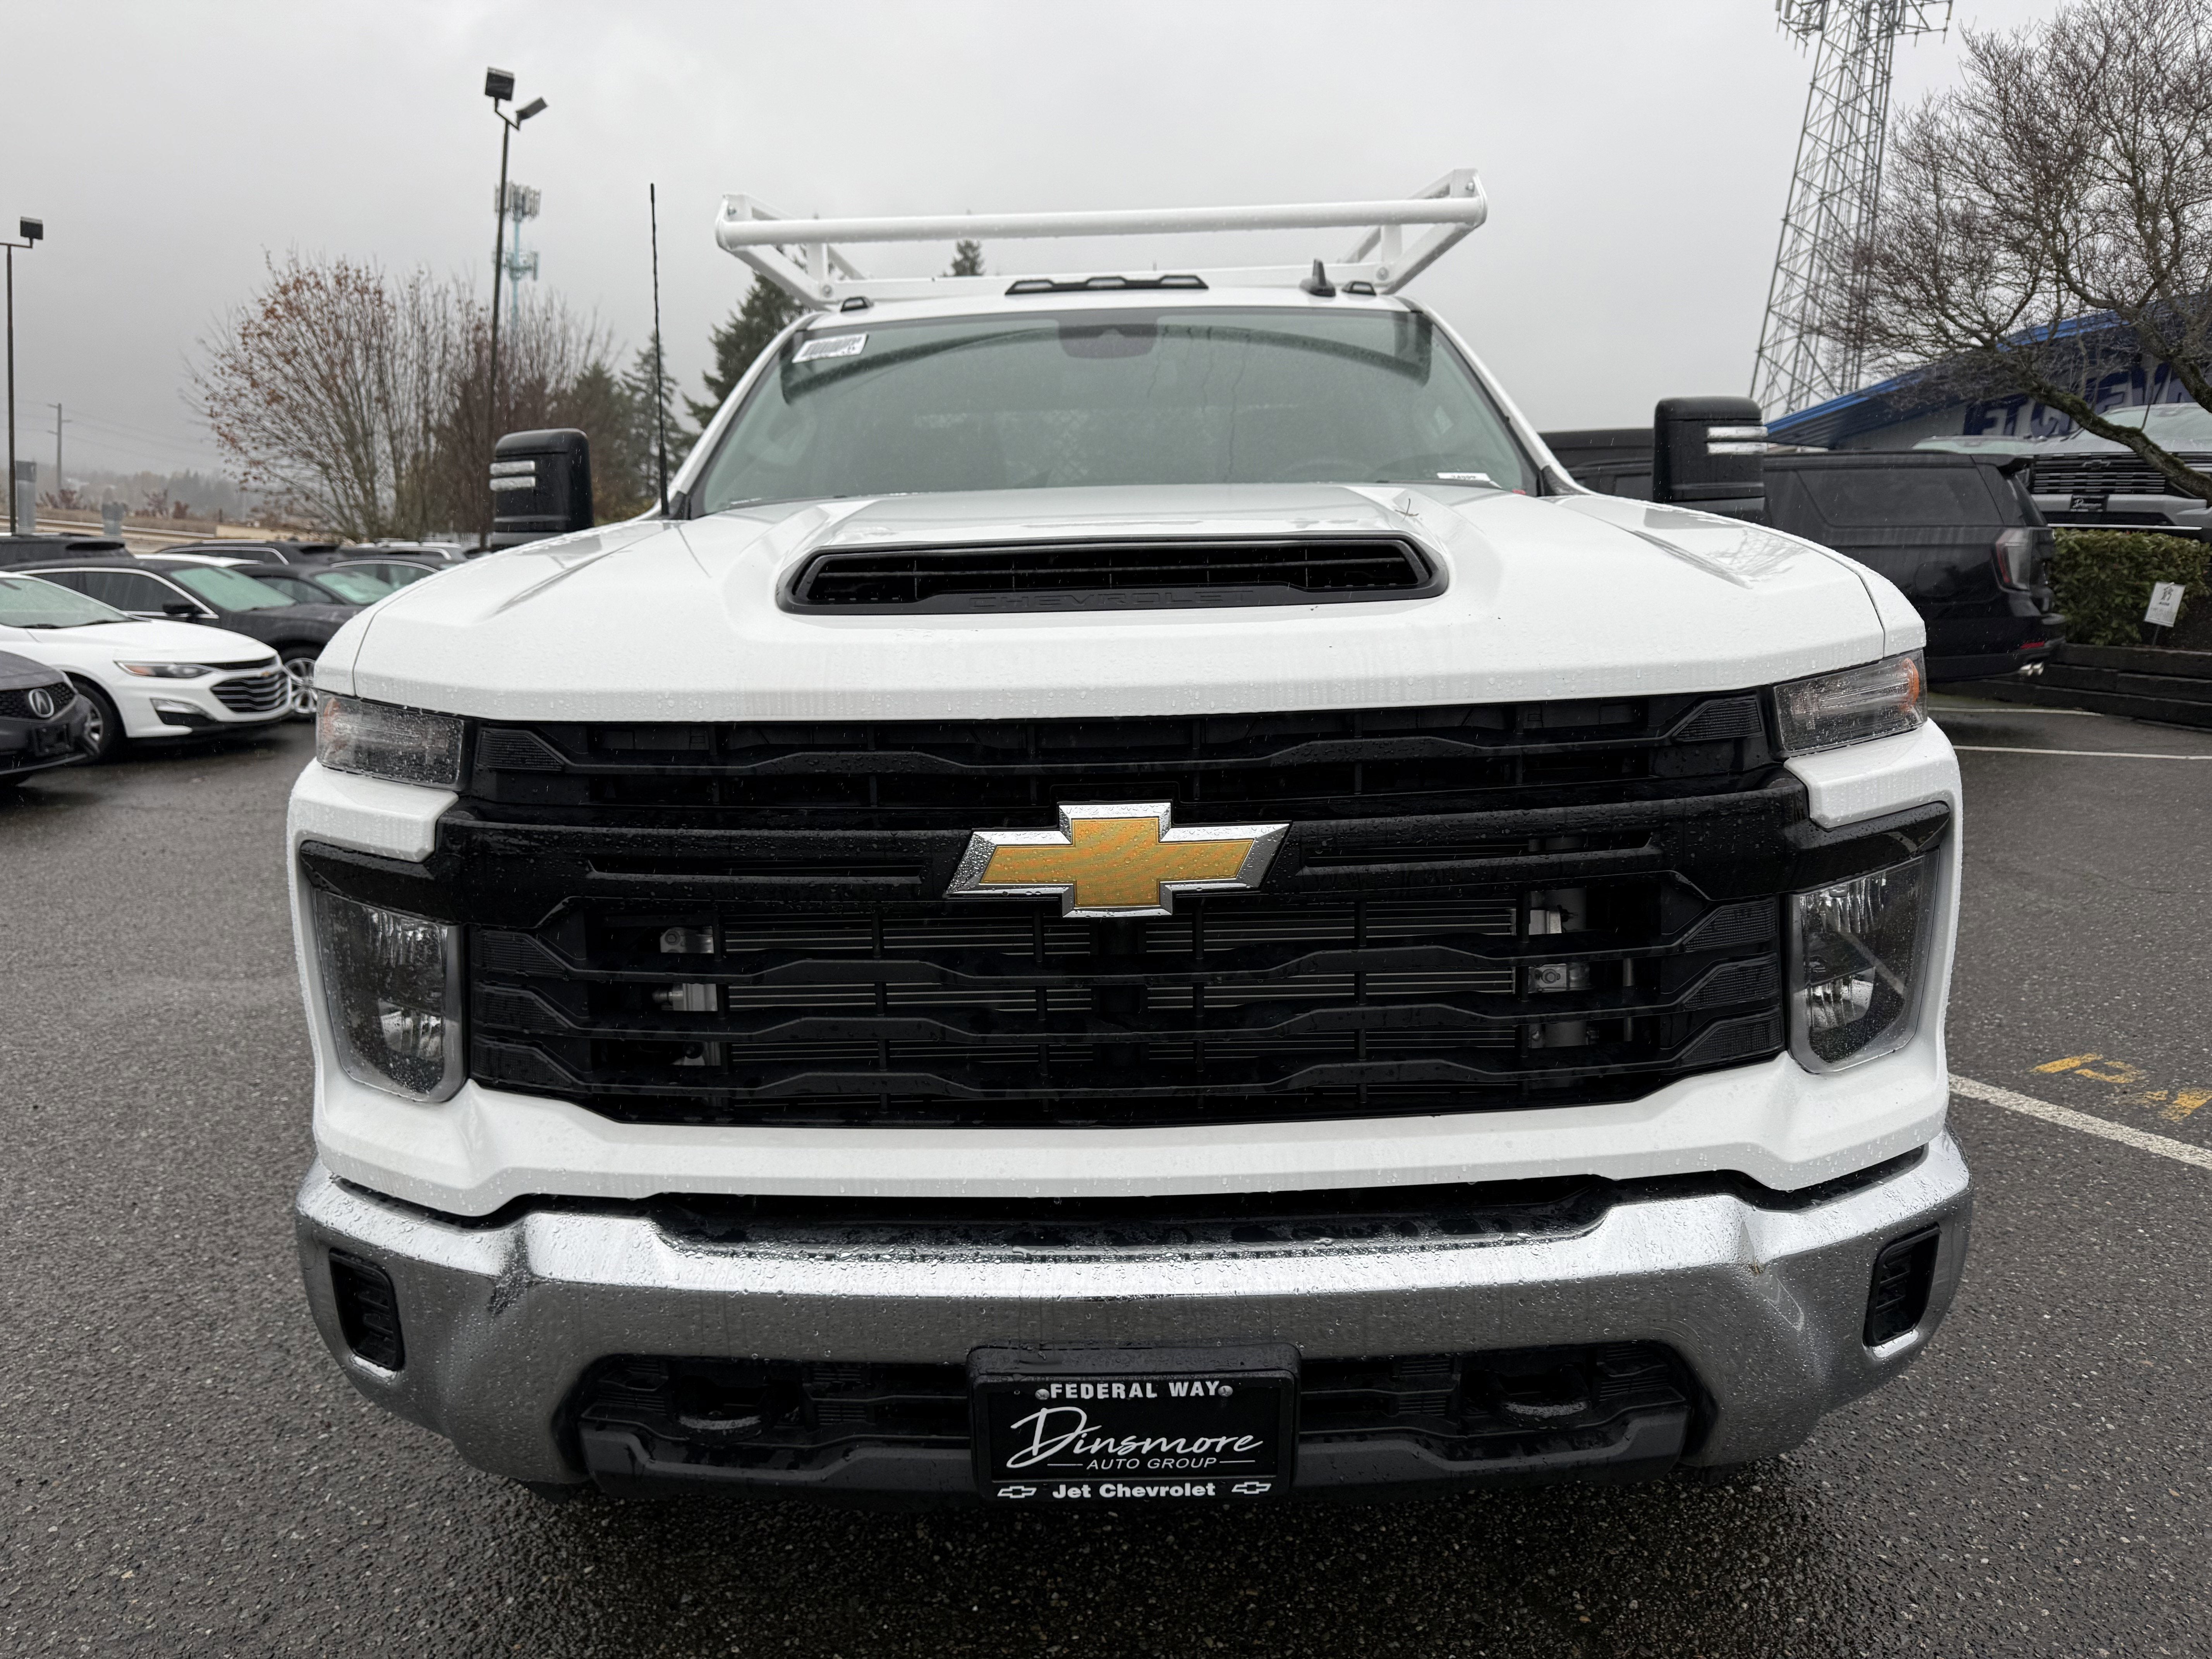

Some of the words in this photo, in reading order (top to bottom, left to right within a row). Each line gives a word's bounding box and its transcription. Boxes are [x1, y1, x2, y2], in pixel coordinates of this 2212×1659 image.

[969, 591, 1254, 608] CHEVROLET
[1051, 1383, 1157, 1399] FEDERAL
[1169, 1381, 1219, 1396] WAY
[1006, 1407, 1263, 1468] Dinsmore
[1087, 1458, 1139, 1469] AUTO
[1147, 1458, 1216, 1468] GROUP
[1053, 1484, 1091, 1498] Jet
[1099, 1483, 1215, 1498] Chevrolet
